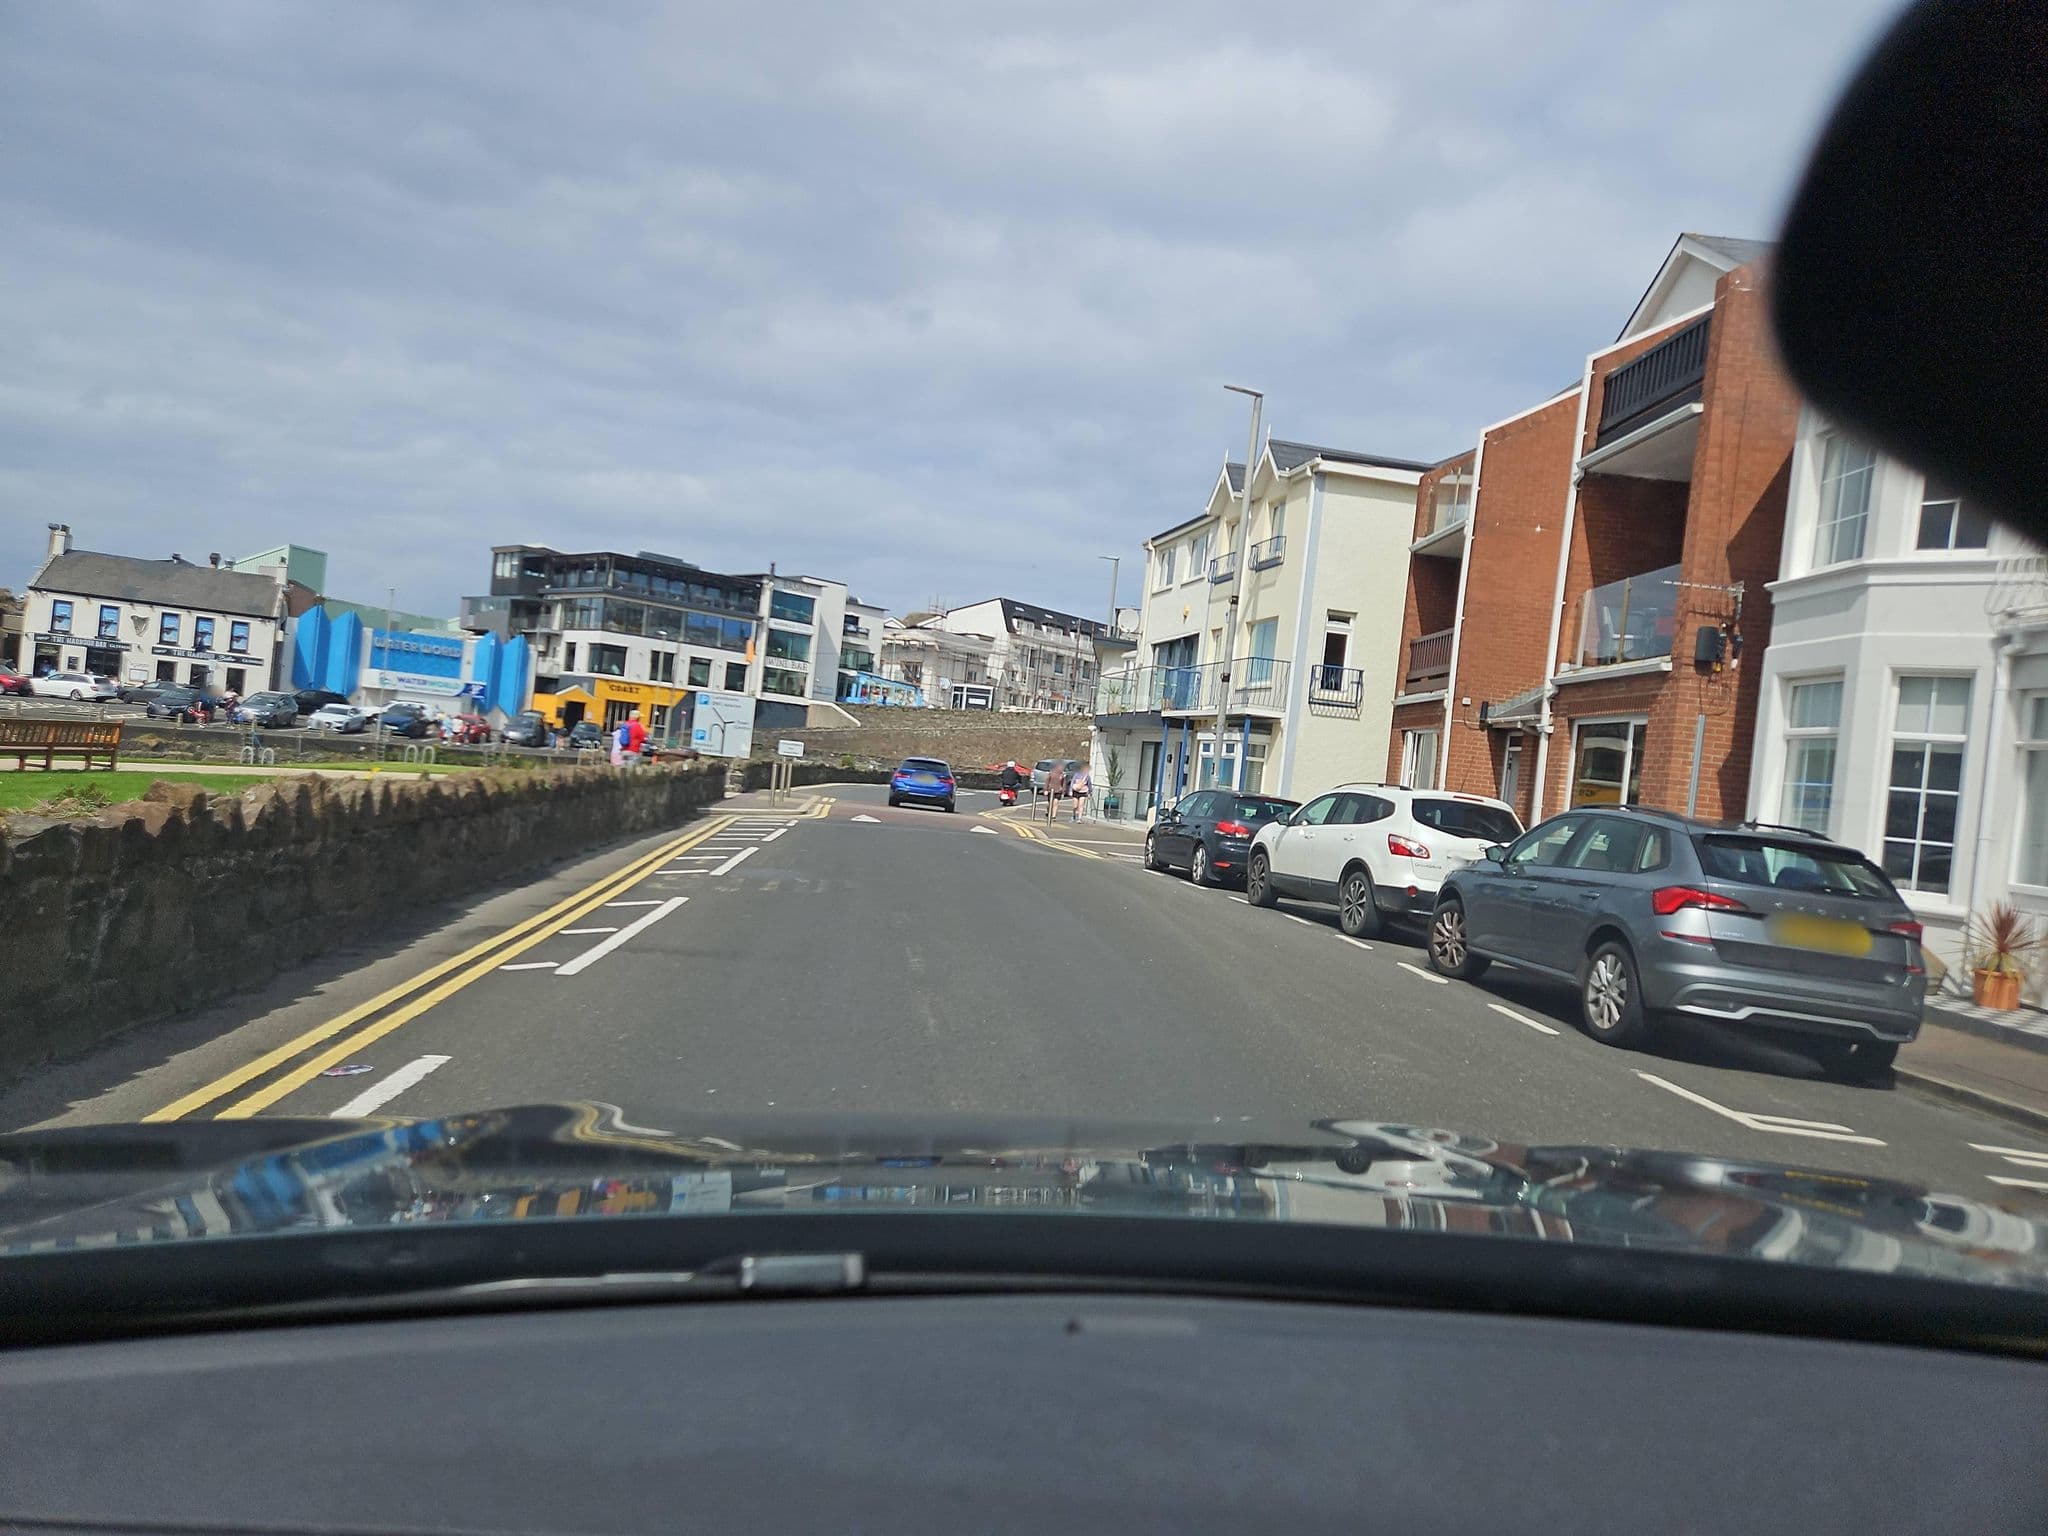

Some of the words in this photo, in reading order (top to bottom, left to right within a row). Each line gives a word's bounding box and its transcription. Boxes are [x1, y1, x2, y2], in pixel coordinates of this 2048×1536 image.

[375, 637, 418, 652] WATER
[422, 645, 462, 658] WORLD
[768, 658, 788, 668] WINE
[791, 662, 808, 671] BAR
